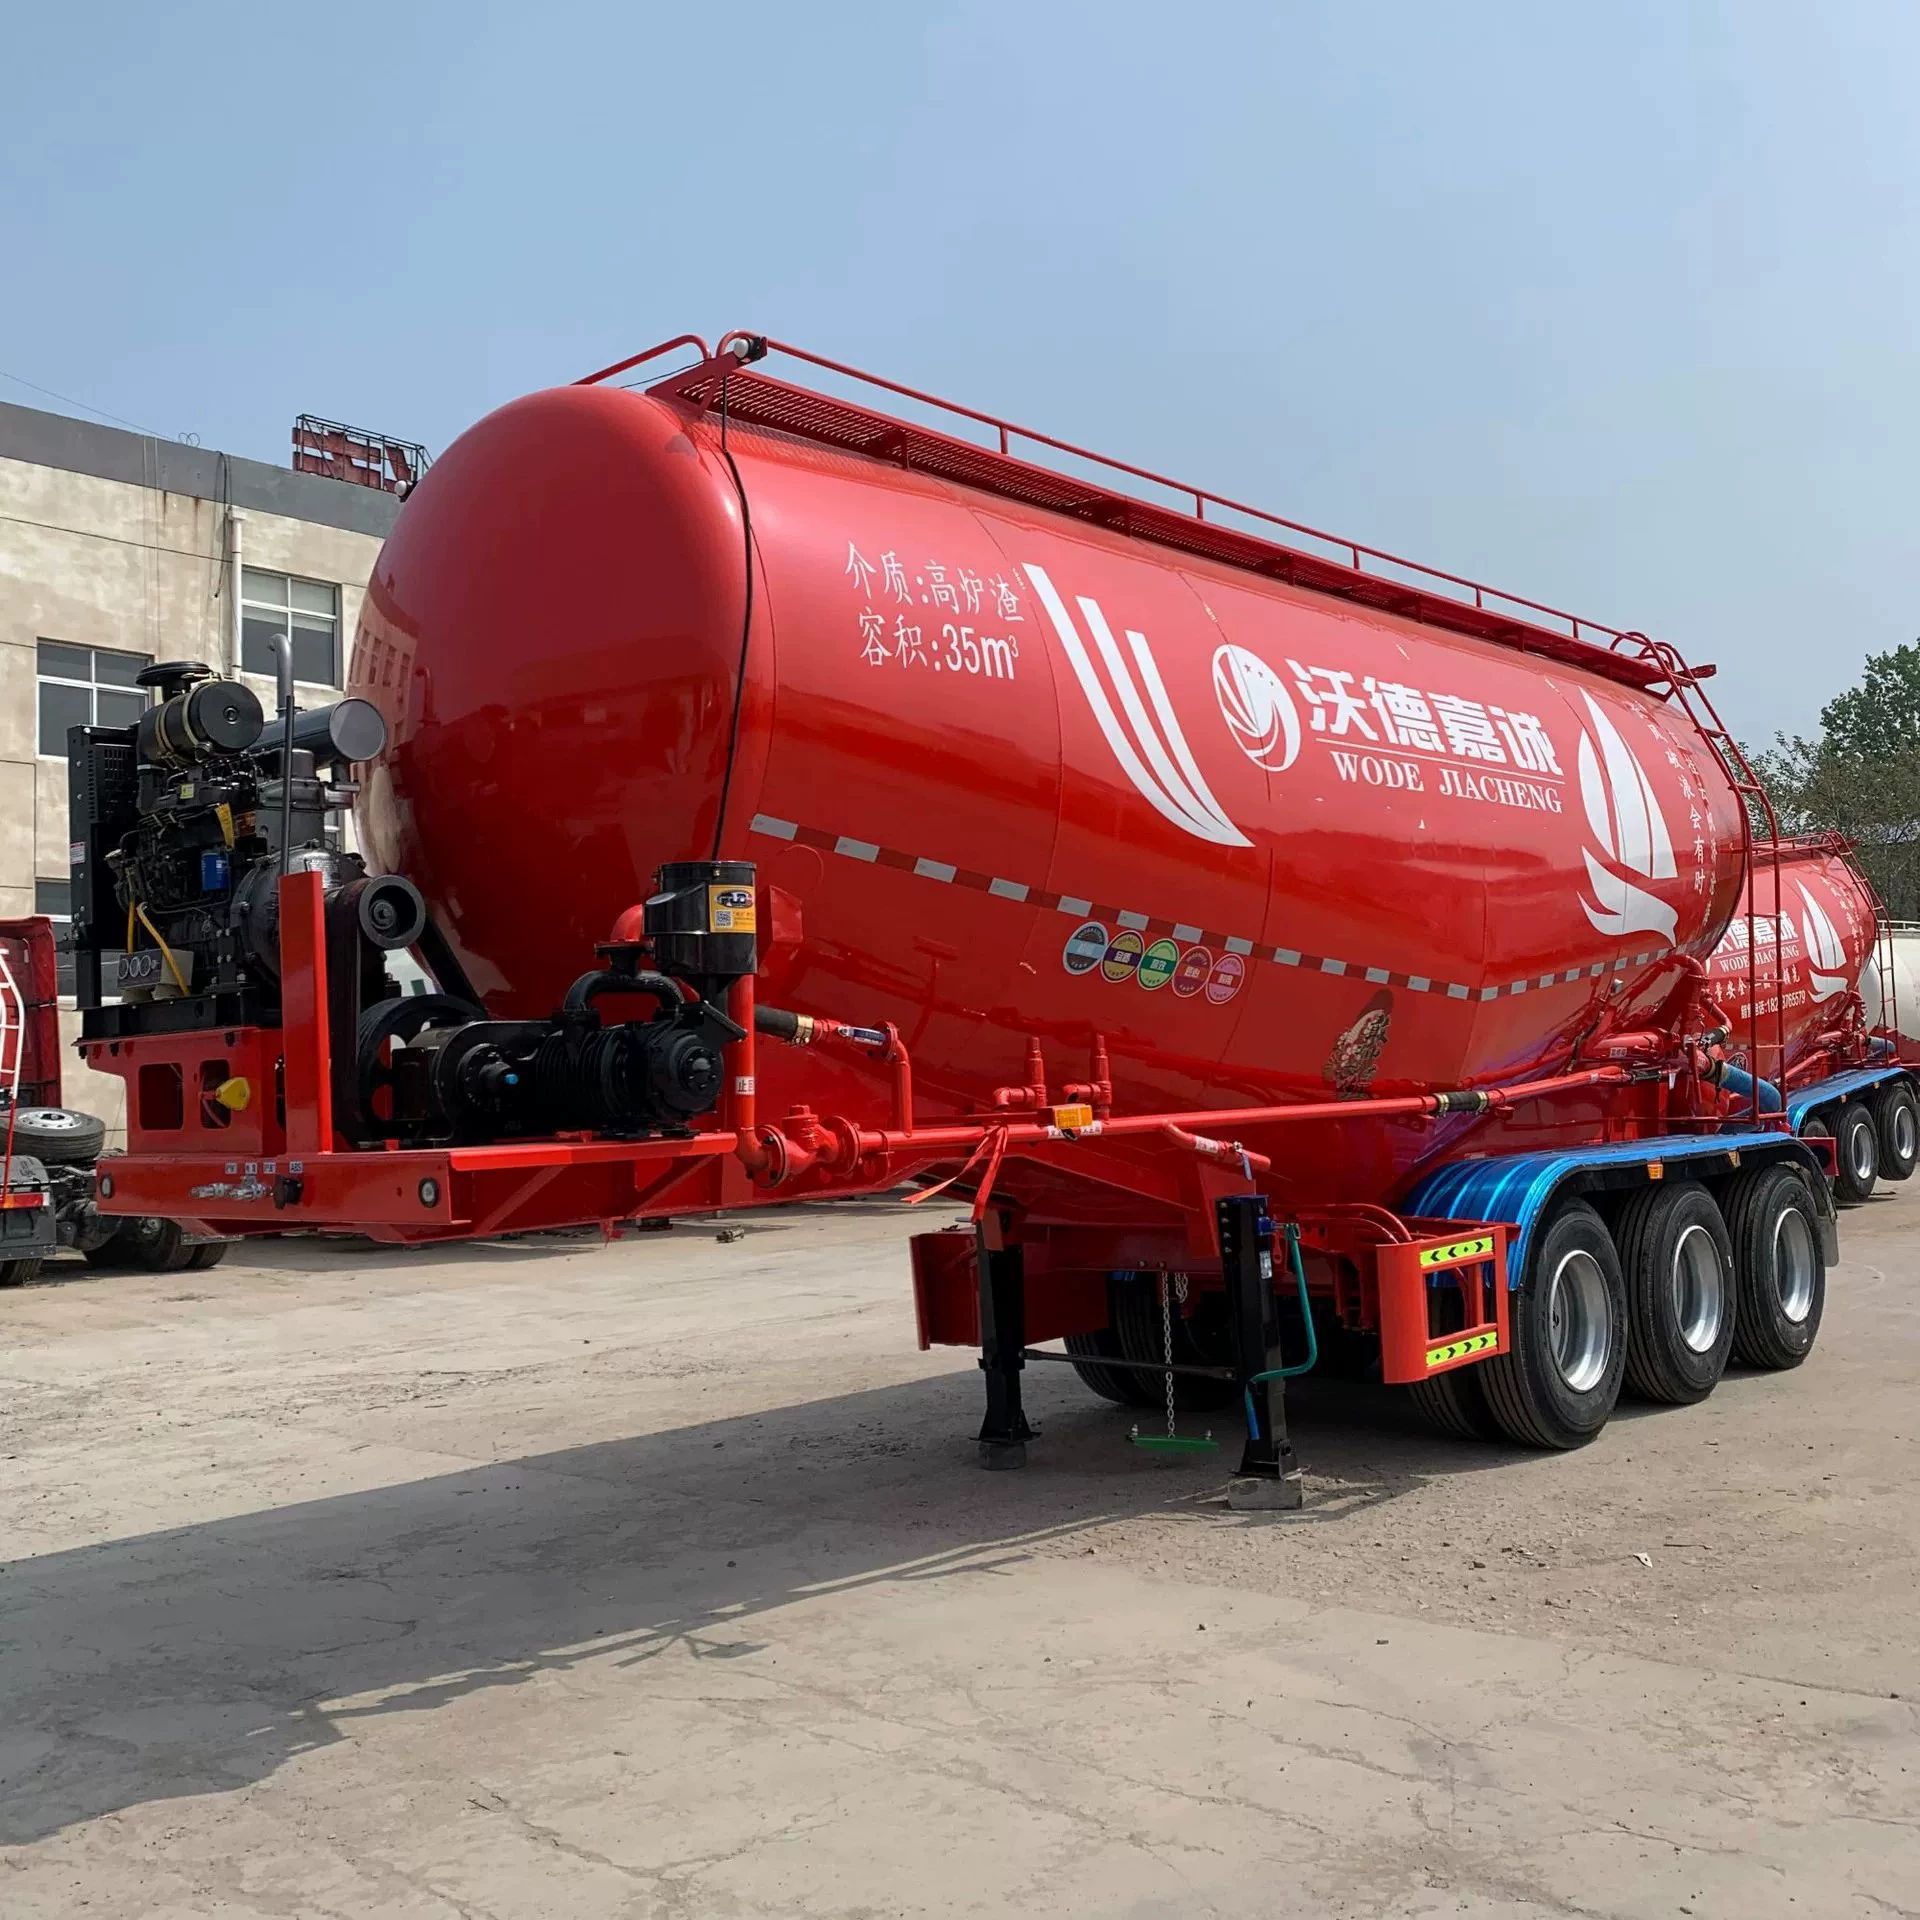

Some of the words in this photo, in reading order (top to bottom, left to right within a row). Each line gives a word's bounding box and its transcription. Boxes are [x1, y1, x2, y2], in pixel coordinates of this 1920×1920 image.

[845, 540, 1025, 622] 介质:高炉渣
[1285, 658, 1564, 776] 沃德嘉诚
[1330, 750, 1424, 793] WODE
[1439, 770, 1564, 814] JIACHENG
[1720, 957, 1749, 973] WODE
[1755, 944, 1800, 966] JIACENG
